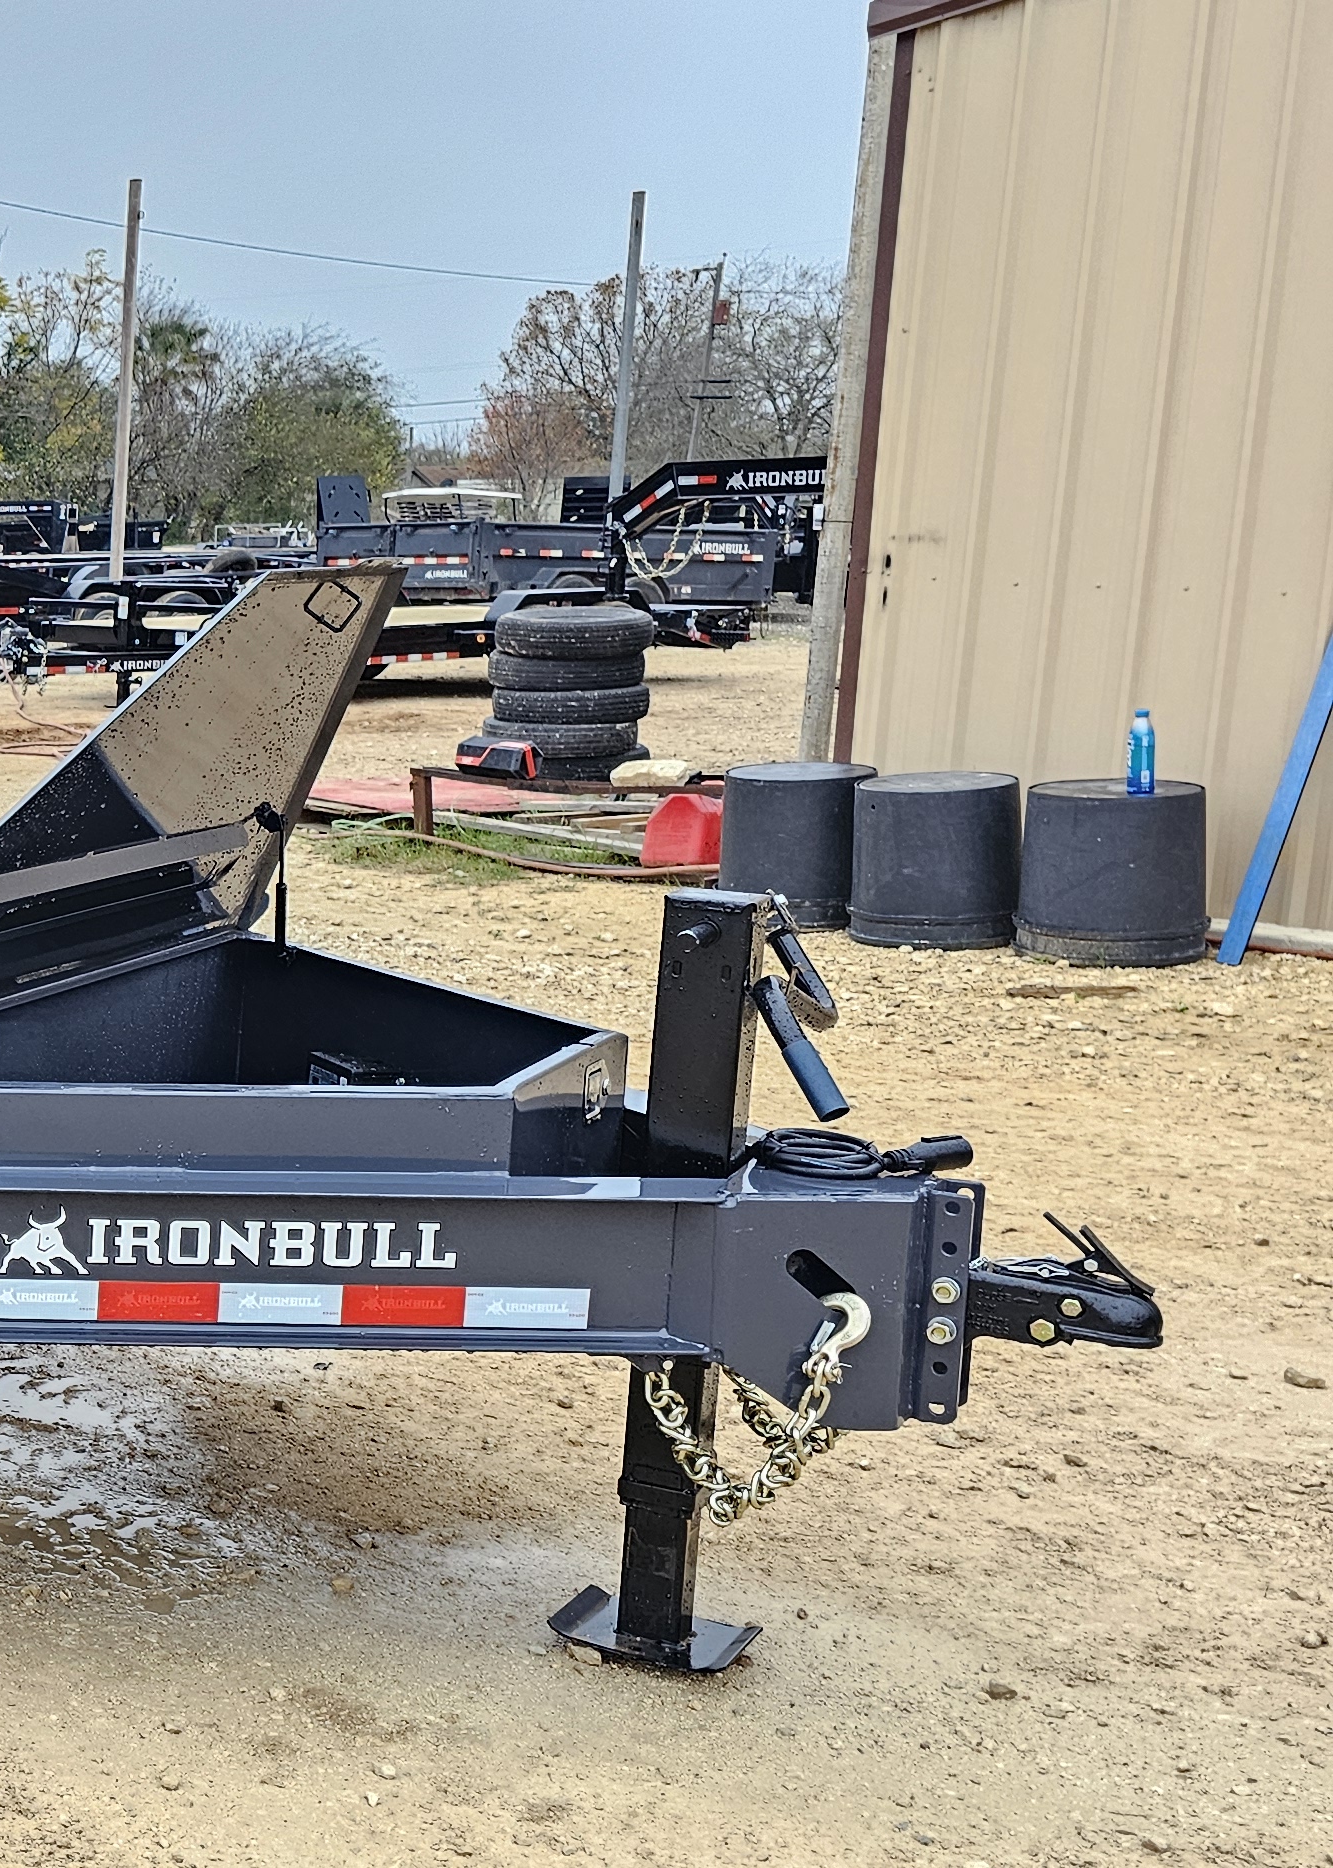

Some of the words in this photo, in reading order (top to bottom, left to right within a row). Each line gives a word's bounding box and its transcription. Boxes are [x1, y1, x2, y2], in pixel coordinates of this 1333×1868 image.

[701, 542, 751, 555] IRONBULL
[86, 1217, 458, 1269] IRONBULL
[15, 1292, 80, 1304] IRONBULL
[137, 1293, 201, 1306] IRONBULL
[257, 1295, 322, 1308] IRONBULL
[382, 1297, 446, 1311] IRONBULL
[505, 1300, 570, 1314] IRONBULL
